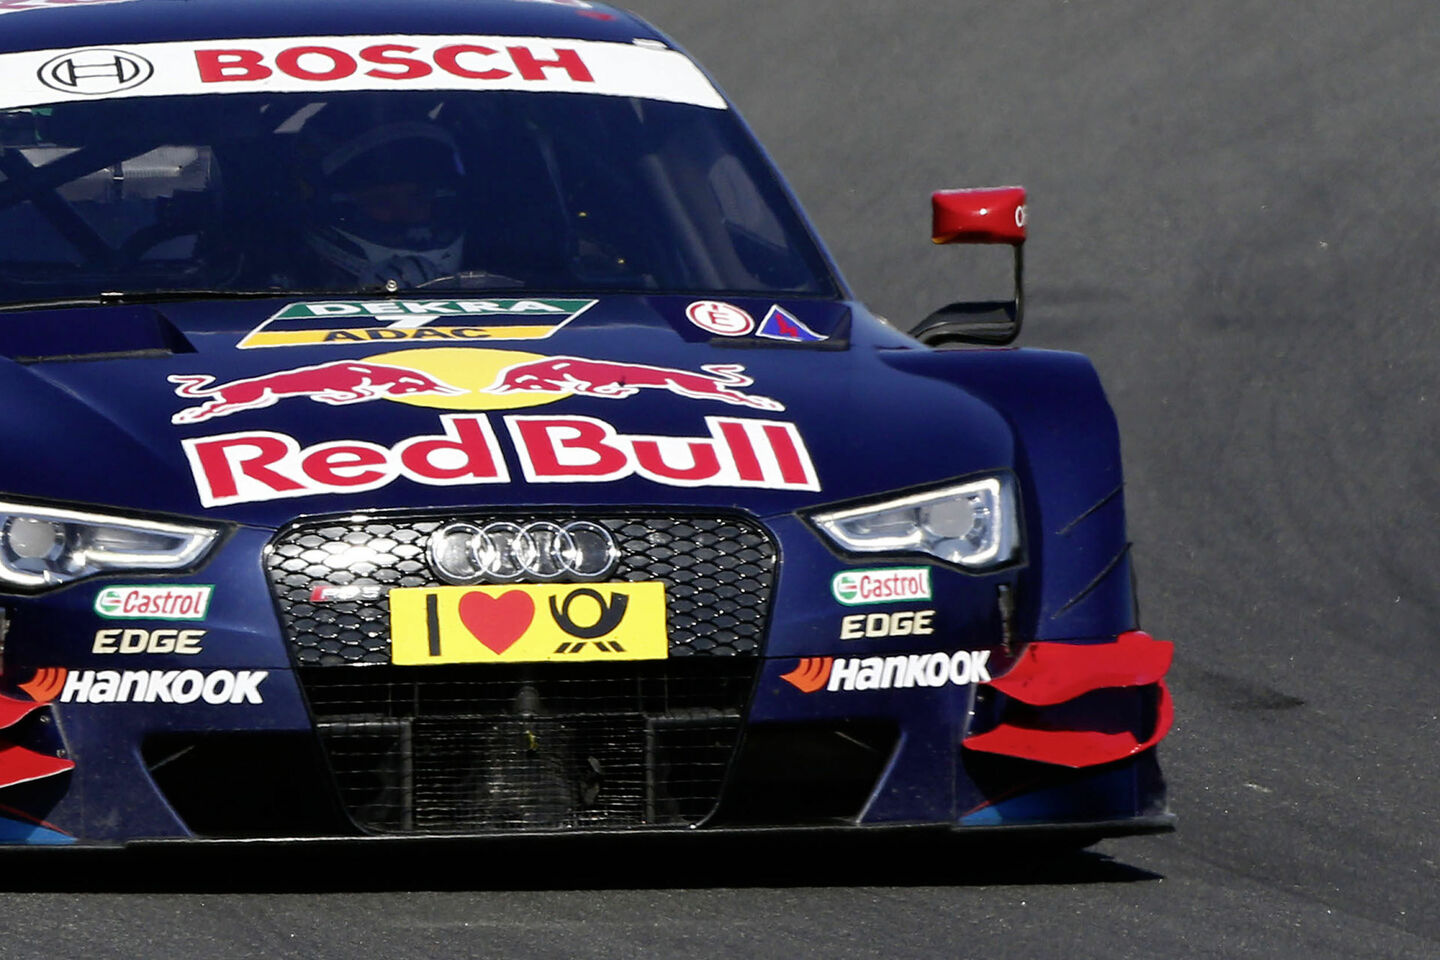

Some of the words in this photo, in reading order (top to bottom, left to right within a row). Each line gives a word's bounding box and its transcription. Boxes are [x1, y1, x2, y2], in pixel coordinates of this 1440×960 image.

[194, 45, 595, 82] BOSCH
[304, 300, 565, 316] DEKRA
[321, 328, 492, 342] ADAC
[184, 414, 509, 506] Red
[507, 416, 821, 491] Bull
[860, 573, 926, 599] Castrol
[122, 590, 201, 615] Castrol
[426, 594, 442, 657] I
[840, 610, 937, 640] EDGE
[92, 628, 208, 654] EDGE
